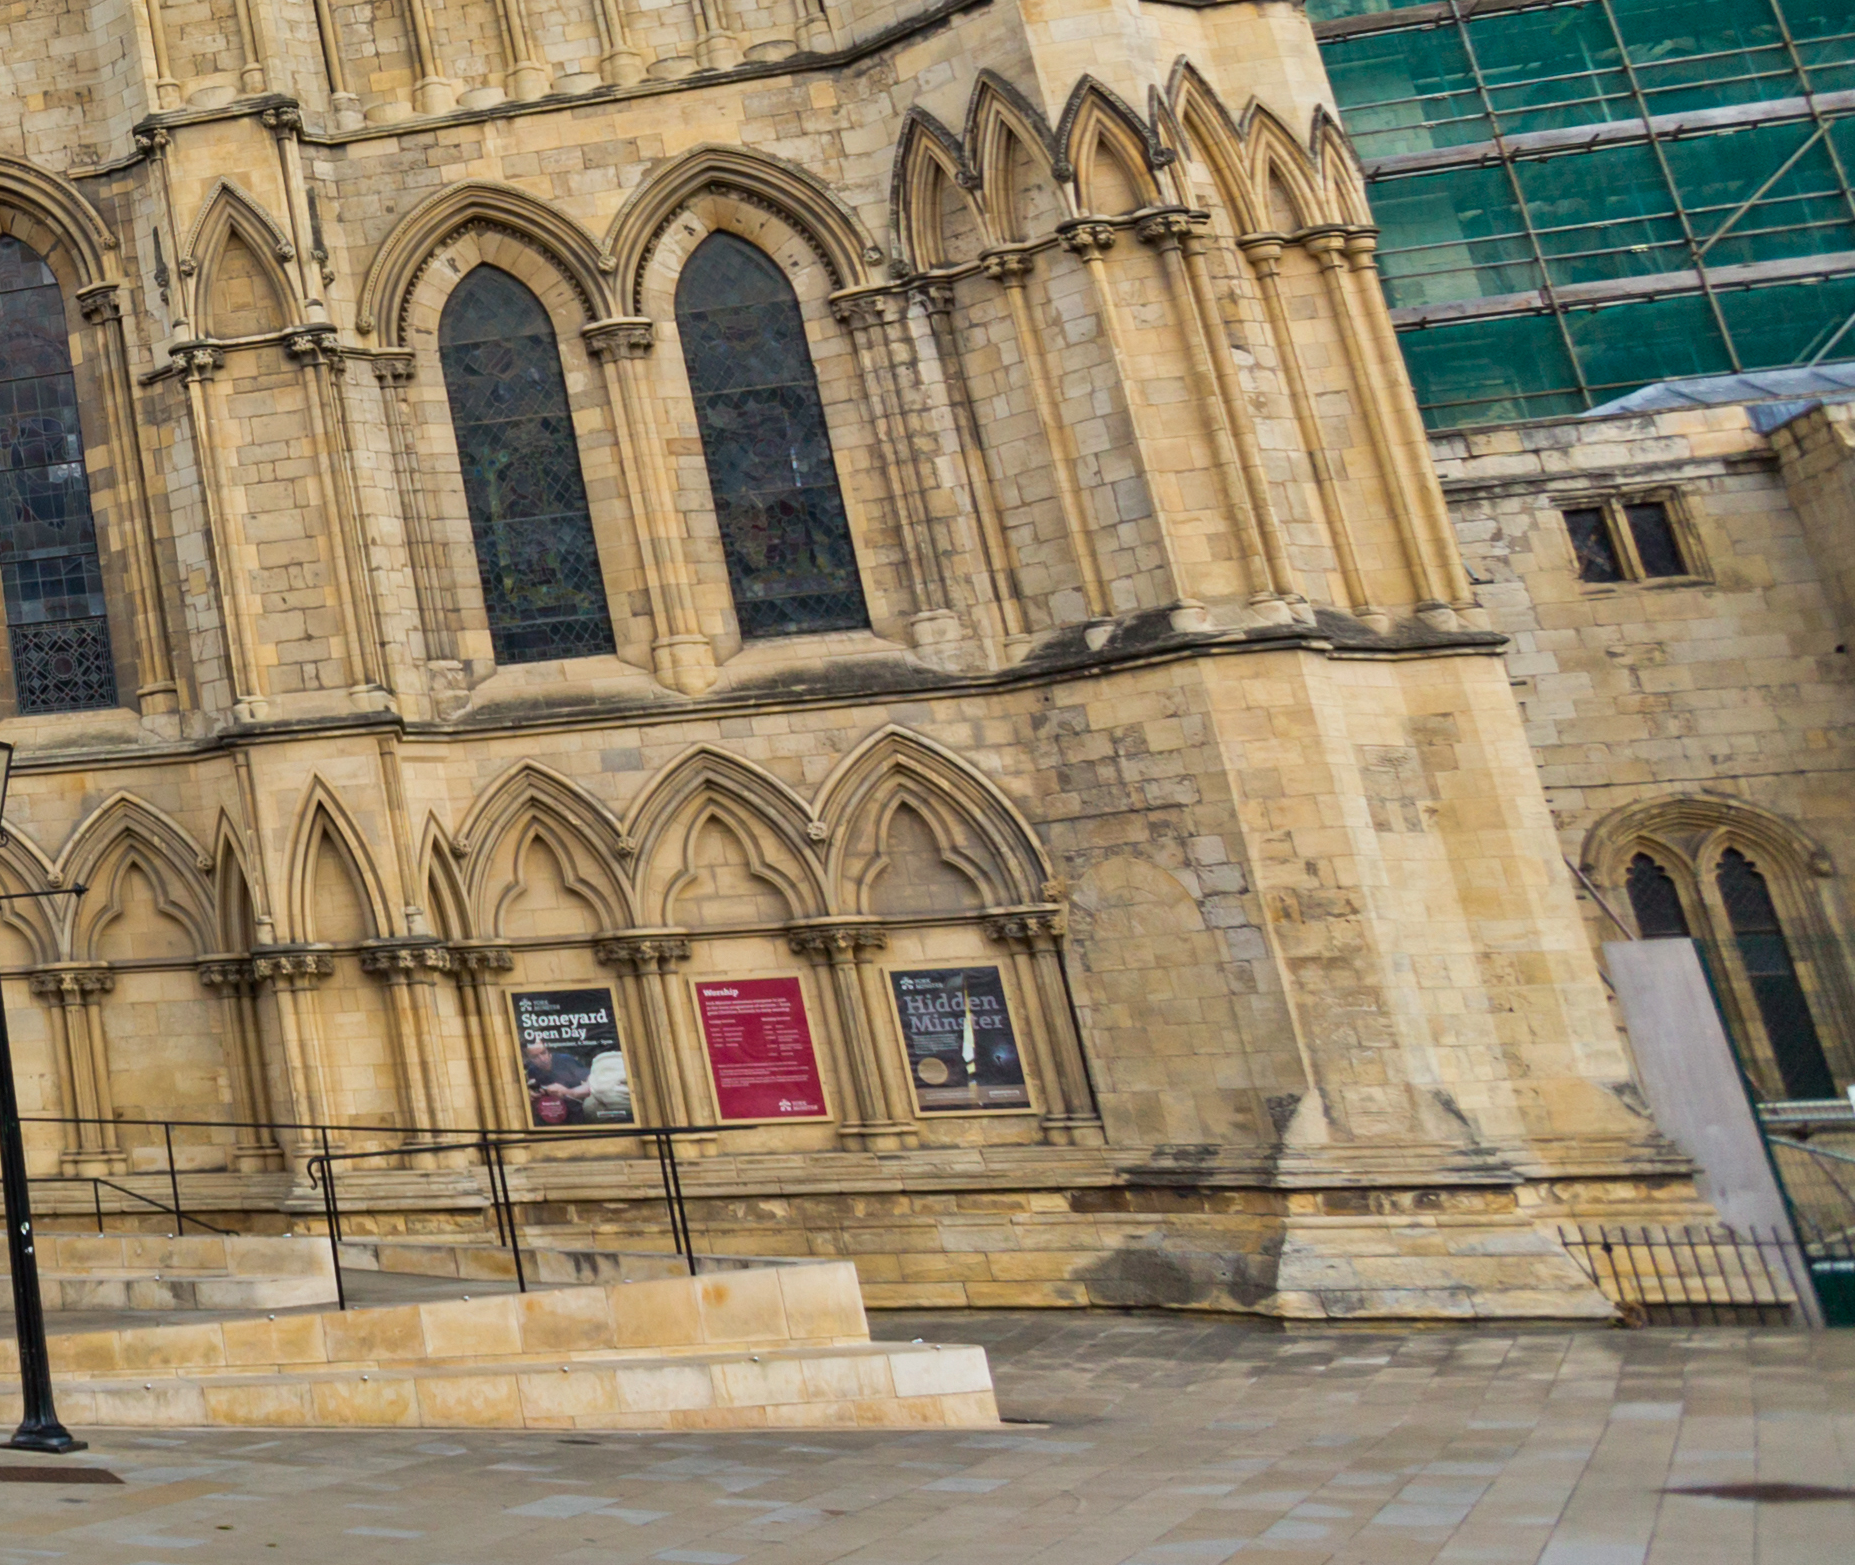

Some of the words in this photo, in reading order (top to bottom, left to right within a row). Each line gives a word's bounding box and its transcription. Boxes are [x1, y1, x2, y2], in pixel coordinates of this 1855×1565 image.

[703, 988, 739, 998] Worship
[903, 991, 1000, 1014] Hidden
[521, 1008, 609, 1029] Stoneyard
[909, 1013, 1005, 1033] Minster
[523, 1028, 560, 1043] Open
[561, 1026, 587, 1041] Day
